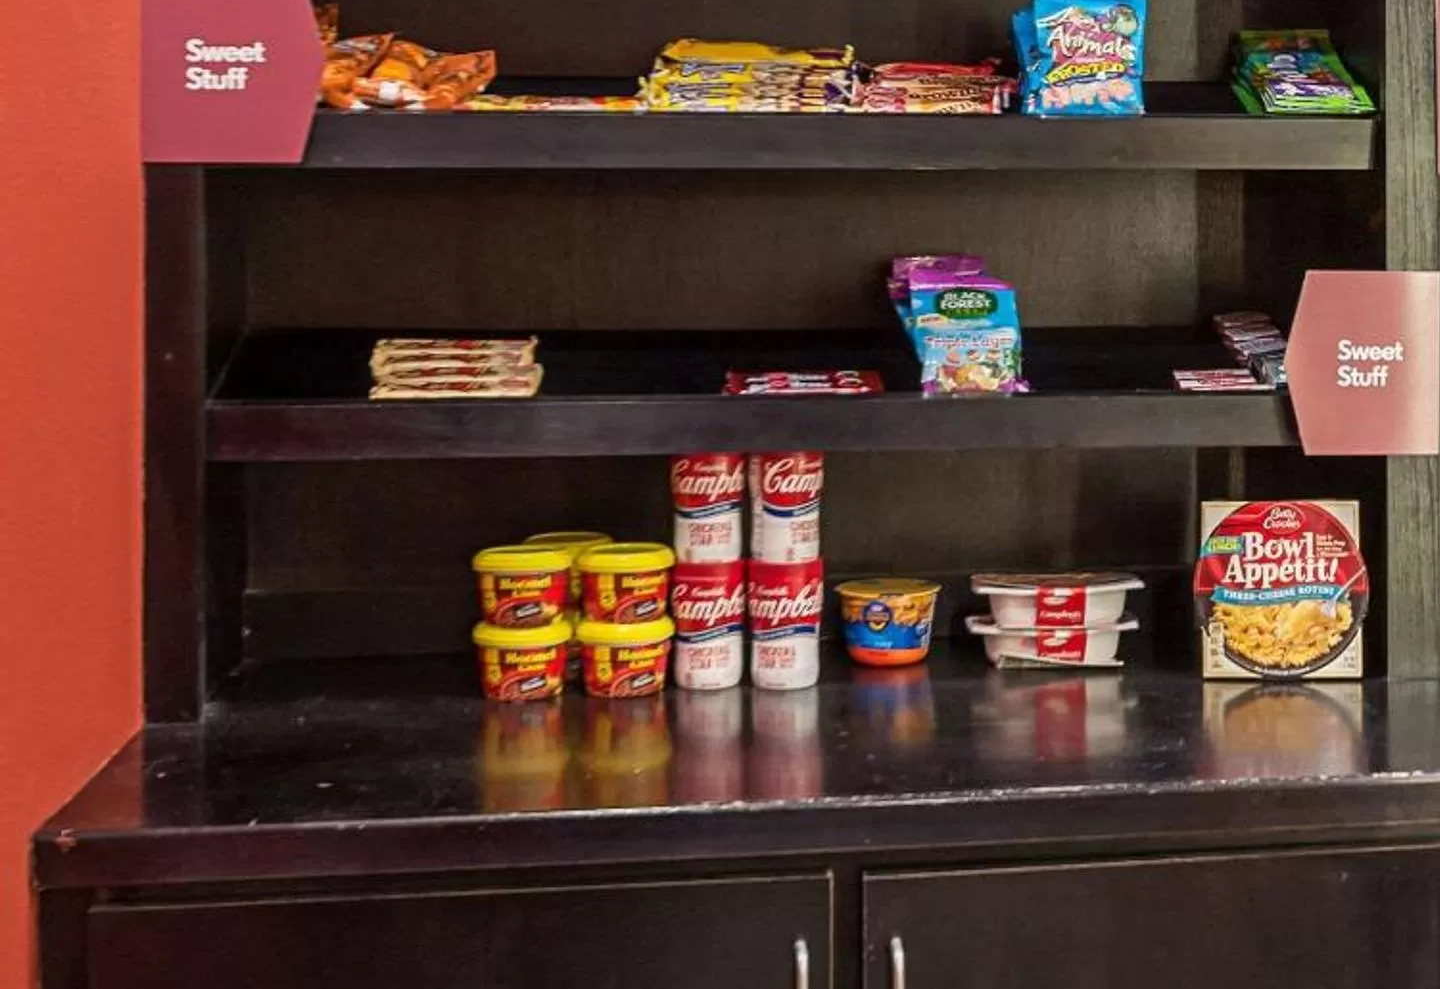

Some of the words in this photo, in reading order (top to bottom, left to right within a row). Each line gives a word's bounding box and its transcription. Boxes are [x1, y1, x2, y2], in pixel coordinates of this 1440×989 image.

[184, 38, 268, 63] Sweet
[184, 67, 249, 90] Stuff
[939, 298, 992, 310] FOREST
[943, 292, 986, 301] BLACK
[1336, 339, 1404, 361] Sweet
[1336, 365, 1389, 387] Stuff
[1242, 531, 1316, 562] Bowl
